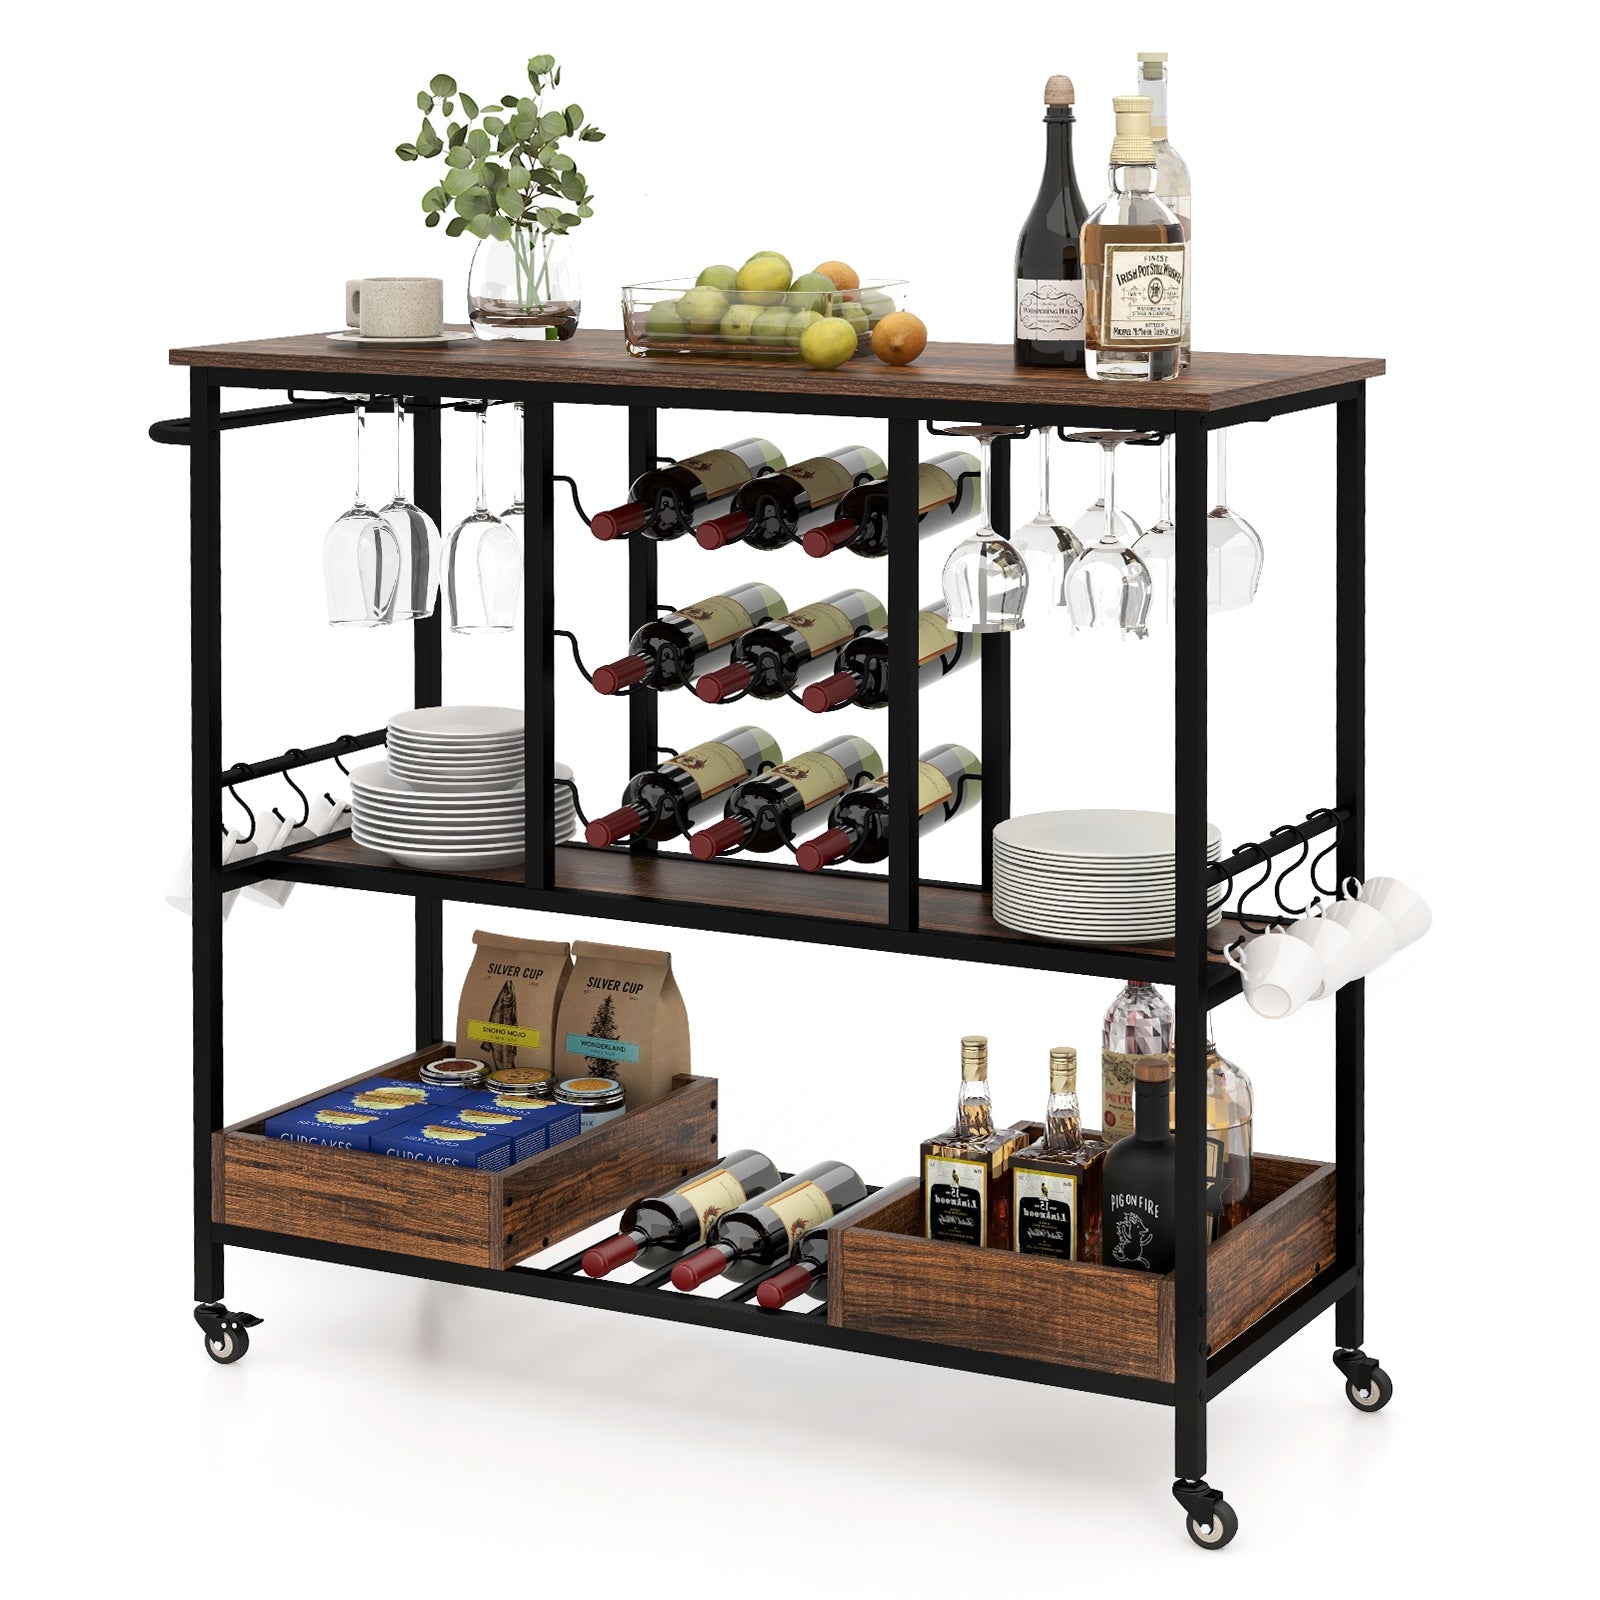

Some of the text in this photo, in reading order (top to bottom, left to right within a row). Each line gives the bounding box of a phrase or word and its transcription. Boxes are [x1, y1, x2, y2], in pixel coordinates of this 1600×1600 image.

[1138, 264, 1149, 278] POT
[487, 963, 544, 980] SILVER CUP
[586, 976, 644, 995] SILVER CUP
[507, 1030, 526, 1038] MOJO
[580, 1040, 626, 1053] WONDERLAND
[1111, 1193, 1159, 1218] PIG ON FIRE
